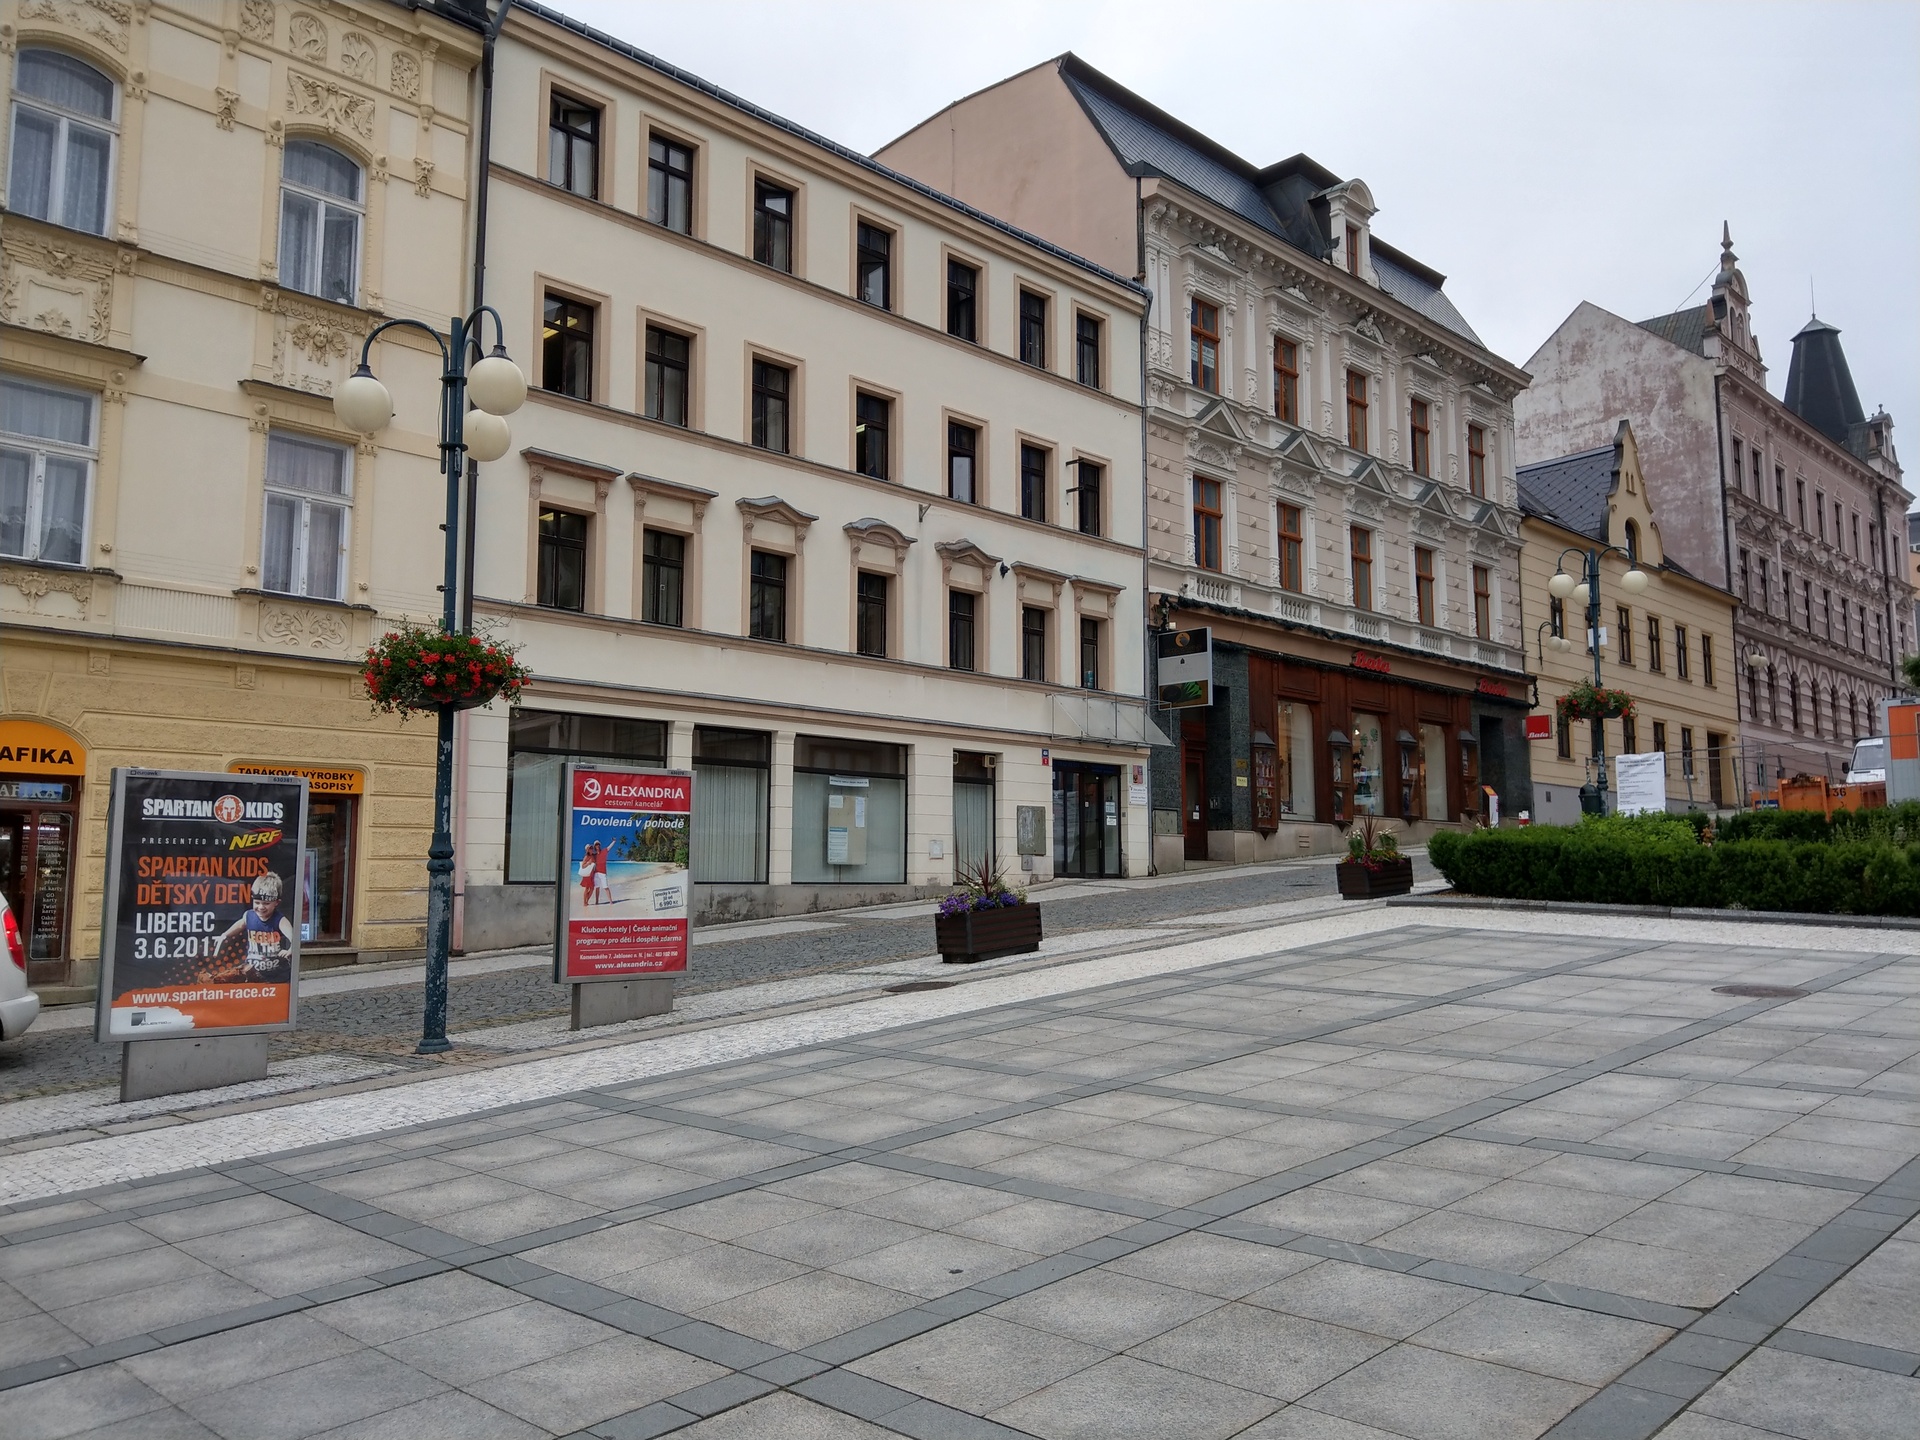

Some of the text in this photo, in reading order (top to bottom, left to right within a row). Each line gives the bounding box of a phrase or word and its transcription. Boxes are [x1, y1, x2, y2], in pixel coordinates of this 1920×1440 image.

[0, 746, 75, 765] AFIKA
[301, 769, 354, 781] VÝROBKY
[604, 783, 685, 800] ALEXANDRIA
[1832, 787, 1847, 797] 36
[142, 798, 284, 819] SPARTAN KIDS
[604, 799, 664, 808] cestovní kancelář
[580, 814, 685, 831] Dovolená v pohodě
[141, 836, 227, 846] PRESENTED BY
[228, 828, 282, 851] NERF
[138, 856, 269, 878] SPARTAN KIDS
[137, 879, 252, 906] DĚTSKÝ DEN
[135, 911, 215, 934] LIBEREC
[581, 923, 678, 934] Klubové hotely České animační
[134, 936, 225, 960] 3.6.2017
[576, 937, 607, 946] programy
[619, 935, 632, 944] děti
[635, 935, 660, 944] dospělé
[660, 934, 682, 942] zdarma
[594, 960, 663, 969] www.alexandria.cz
[132, 986, 276, 1004] www.spartan-race.cz
